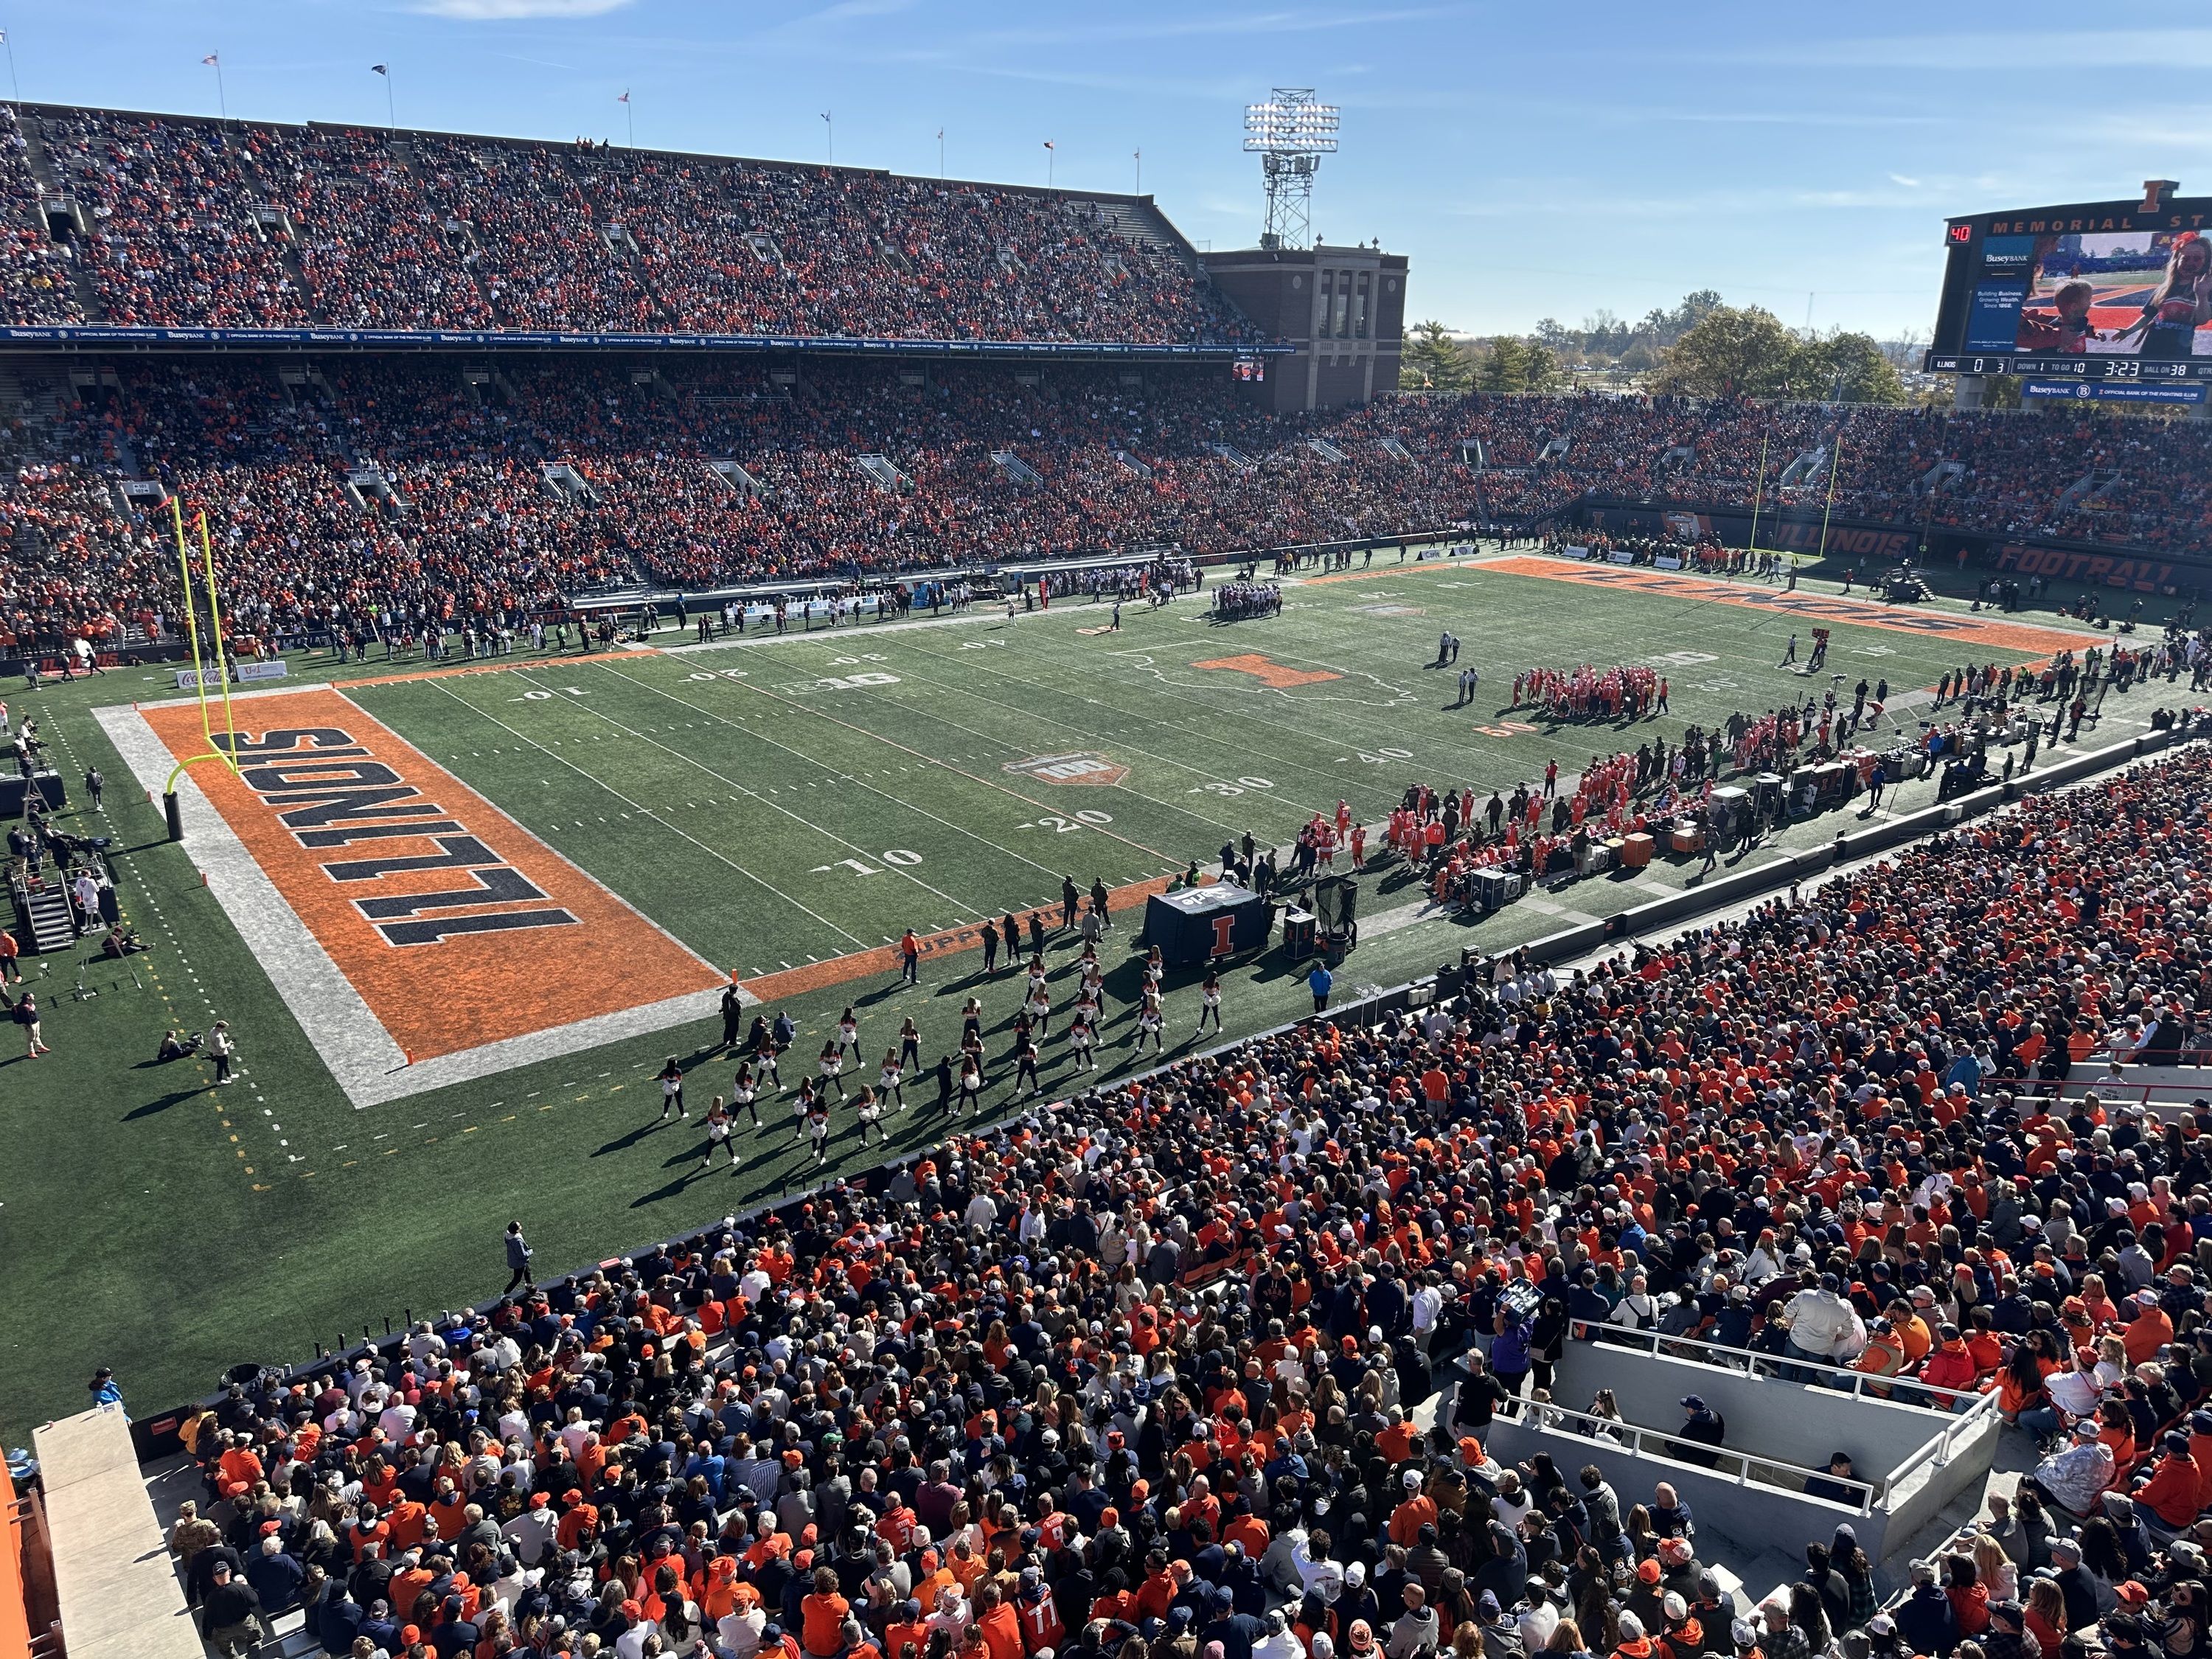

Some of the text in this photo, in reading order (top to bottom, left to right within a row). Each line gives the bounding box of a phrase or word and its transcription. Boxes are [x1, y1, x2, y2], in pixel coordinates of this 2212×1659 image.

[1993, 215, 2212, 234] MEMORIAL ST
[1951, 226, 1969, 241] 40
[10, 330, 52, 339] BuseyBANK
[167, 331, 205, 340] BuseyBANK
[1974, 359, 1983, 372] 0
[1997, 364, 2004, 373] 3
[2040, 363, 2044, 372] 1
[2074, 363, 2085, 373] 10
[2104, 362, 2140, 376] 3:23
[2171, 365, 2187, 376] 38
[2030, 386, 2070, 395] BuseyBANK
[1777, 524, 1910, 556] ILLINOIS
[1196, 556, 1228, 565] ILLINOIS
[1550, 570, 1986, 630] ILLINOIS
[964, 639, 1006, 650] 40
[838, 653, 888, 665] 30
[690, 668, 748, 681] 20
[524, 686, 591, 700] 10
[1686, 680, 1739, 692] 30
[1472, 722, 1538, 737] 50
[1357, 748, 1414, 764] 40
[1033, 759, 1113, 779] 100
[1205, 777, 1275, 796] 30
[1038, 810, 1113, 833] 20
[209, 727, 584, 947] ILLINOIS
[834, 849, 923, 877] 10
[1210, 914, 1235, 957] I
[686, 1272, 696, 1289] 7
[900, 1527, 910, 1546] 3
[1052, 1526, 1064, 1543] 9
